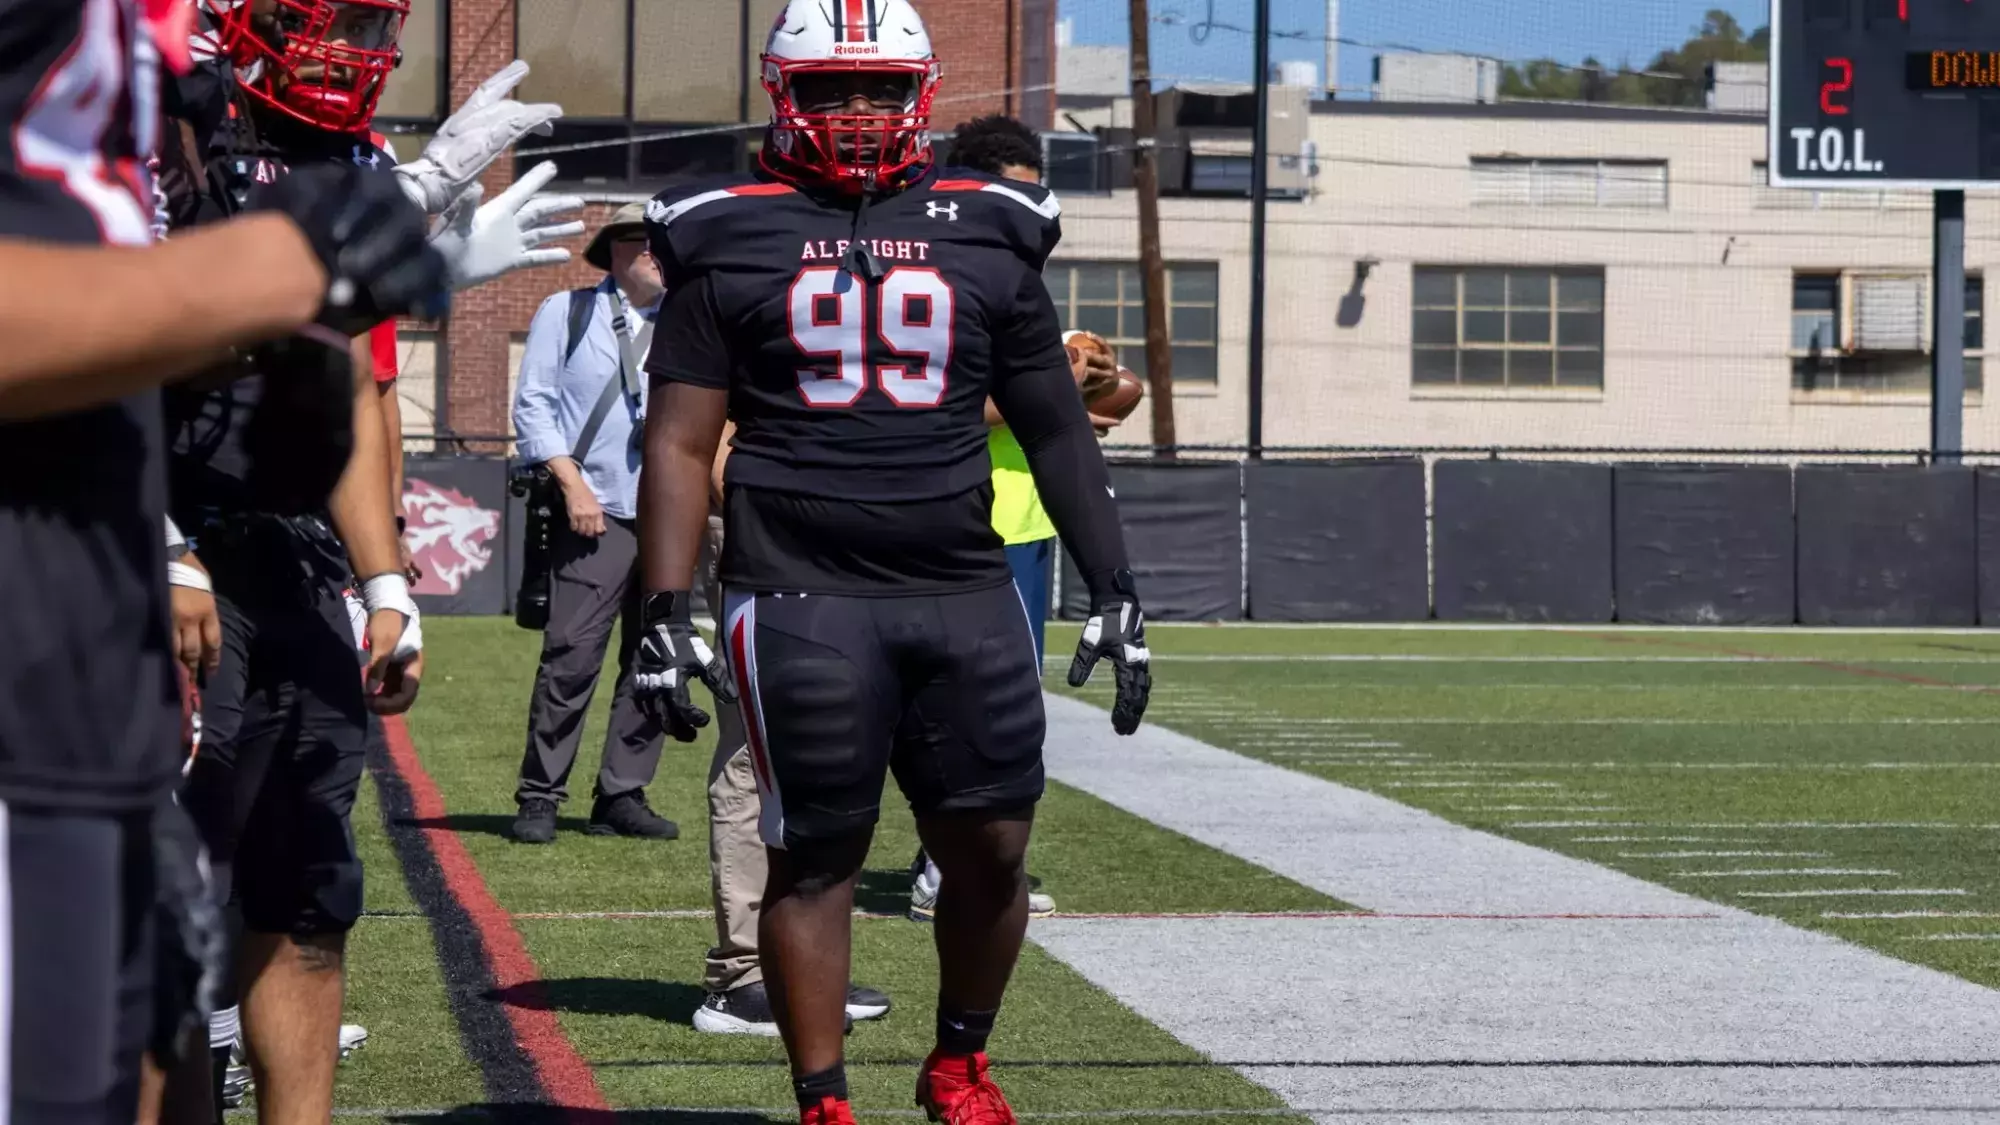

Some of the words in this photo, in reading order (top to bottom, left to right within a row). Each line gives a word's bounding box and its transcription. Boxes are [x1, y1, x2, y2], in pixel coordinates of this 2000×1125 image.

[1820, 57, 1853, 115] 2
[1931, 50, 2000, 87] DOW
[1790, 127, 1884, 171] T.O.L.
[801, 239, 929, 260] ALBIGHT
[787, 266, 955, 408] 99
